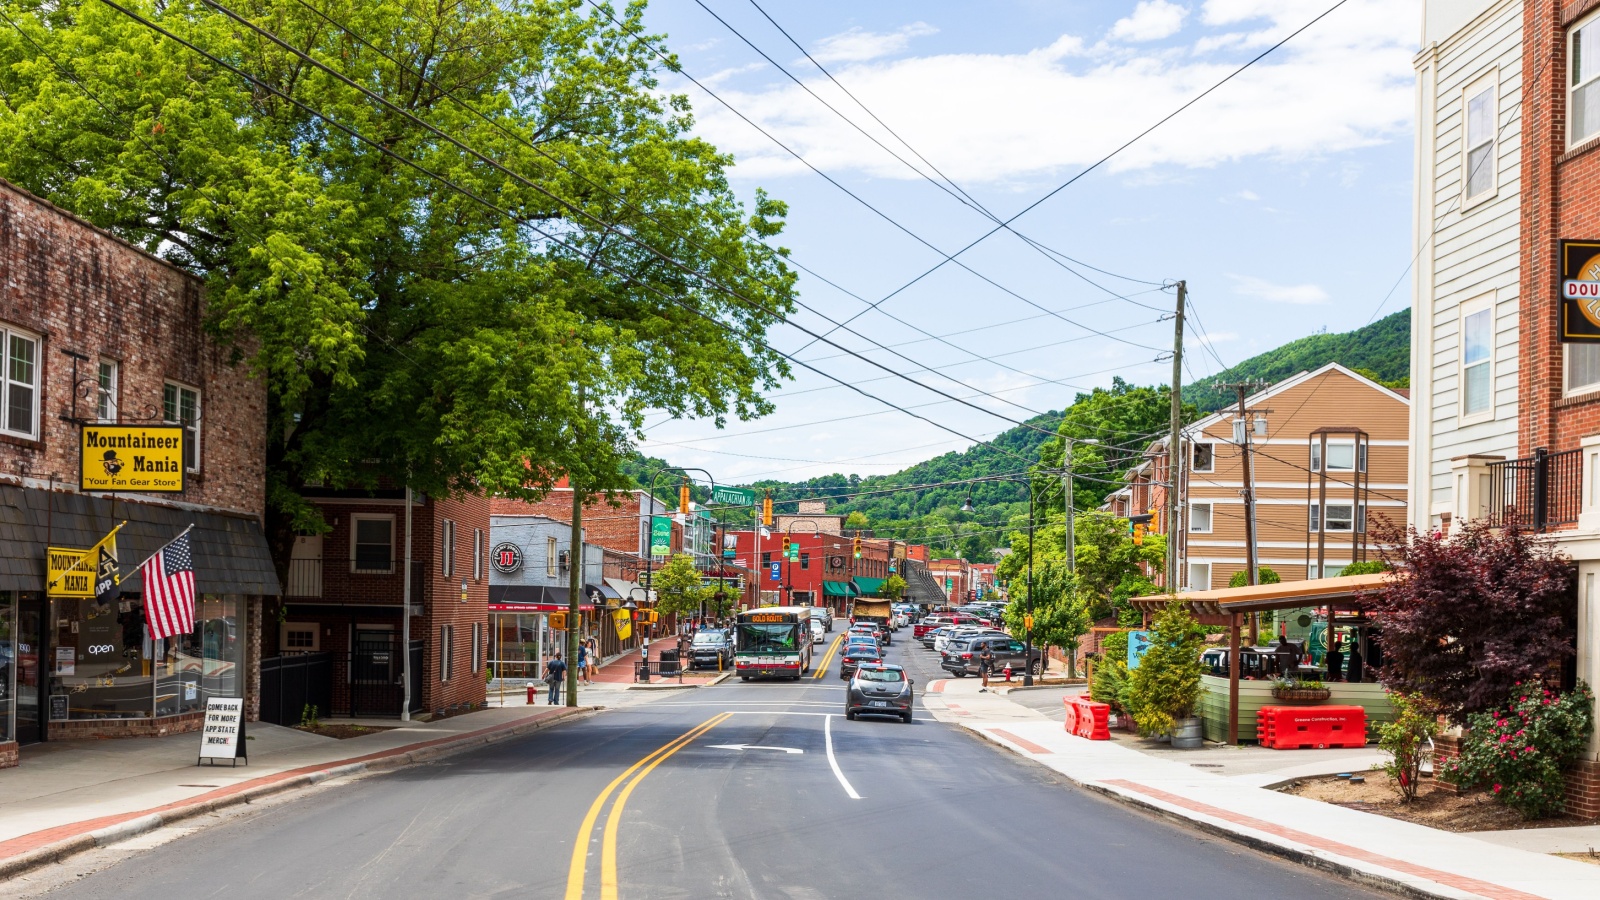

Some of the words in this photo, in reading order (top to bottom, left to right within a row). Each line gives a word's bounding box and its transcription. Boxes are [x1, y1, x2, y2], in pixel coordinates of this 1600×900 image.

[87, 431, 179, 449] Mountaineer
[133, 456, 179, 473] Mania
[85, 478, 109, 486] "Your
[112, 478, 127, 486] Fan
[130, 478, 150, 486] Gear
[153, 478, 181, 486] Store"
[713, 491, 746, 505] APPALACHIAN
[64, 575, 88, 592] MANIA
[752, 615, 766, 623] GOLD
[767, 615, 783, 623] ROUTE
[88, 644, 115, 655] open
[207, 703, 223, 711] COME
[208, 714, 220, 722] FOR
[205, 725, 218, 733] APP
[217, 726, 236, 734] STATE
